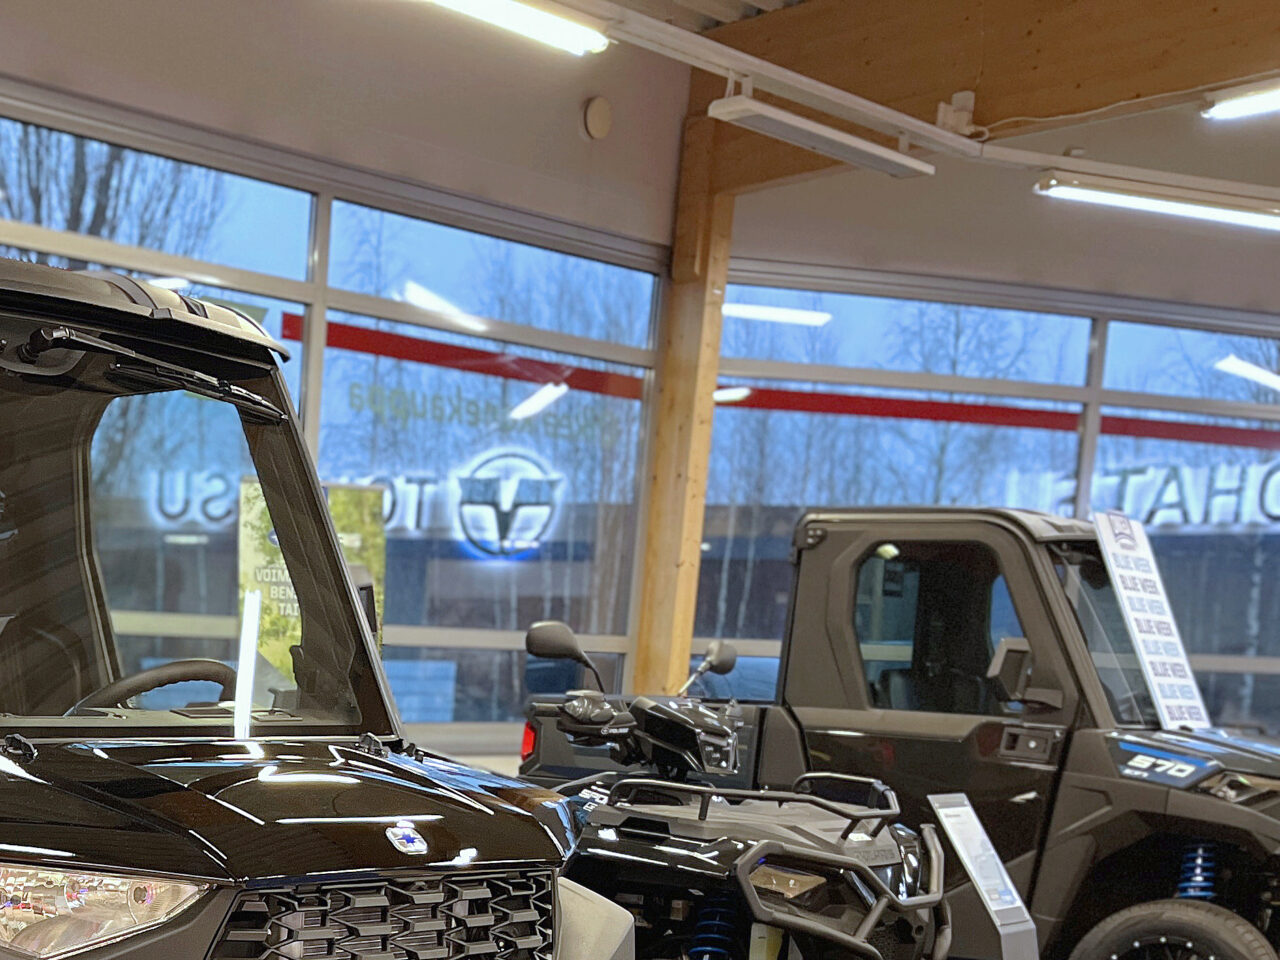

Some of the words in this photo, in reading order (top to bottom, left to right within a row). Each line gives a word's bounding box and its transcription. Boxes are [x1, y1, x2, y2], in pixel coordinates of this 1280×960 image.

[255, 568, 291, 582] VOIM
[270, 585, 298, 599] BEN
[1127, 754, 1197, 778] 570
